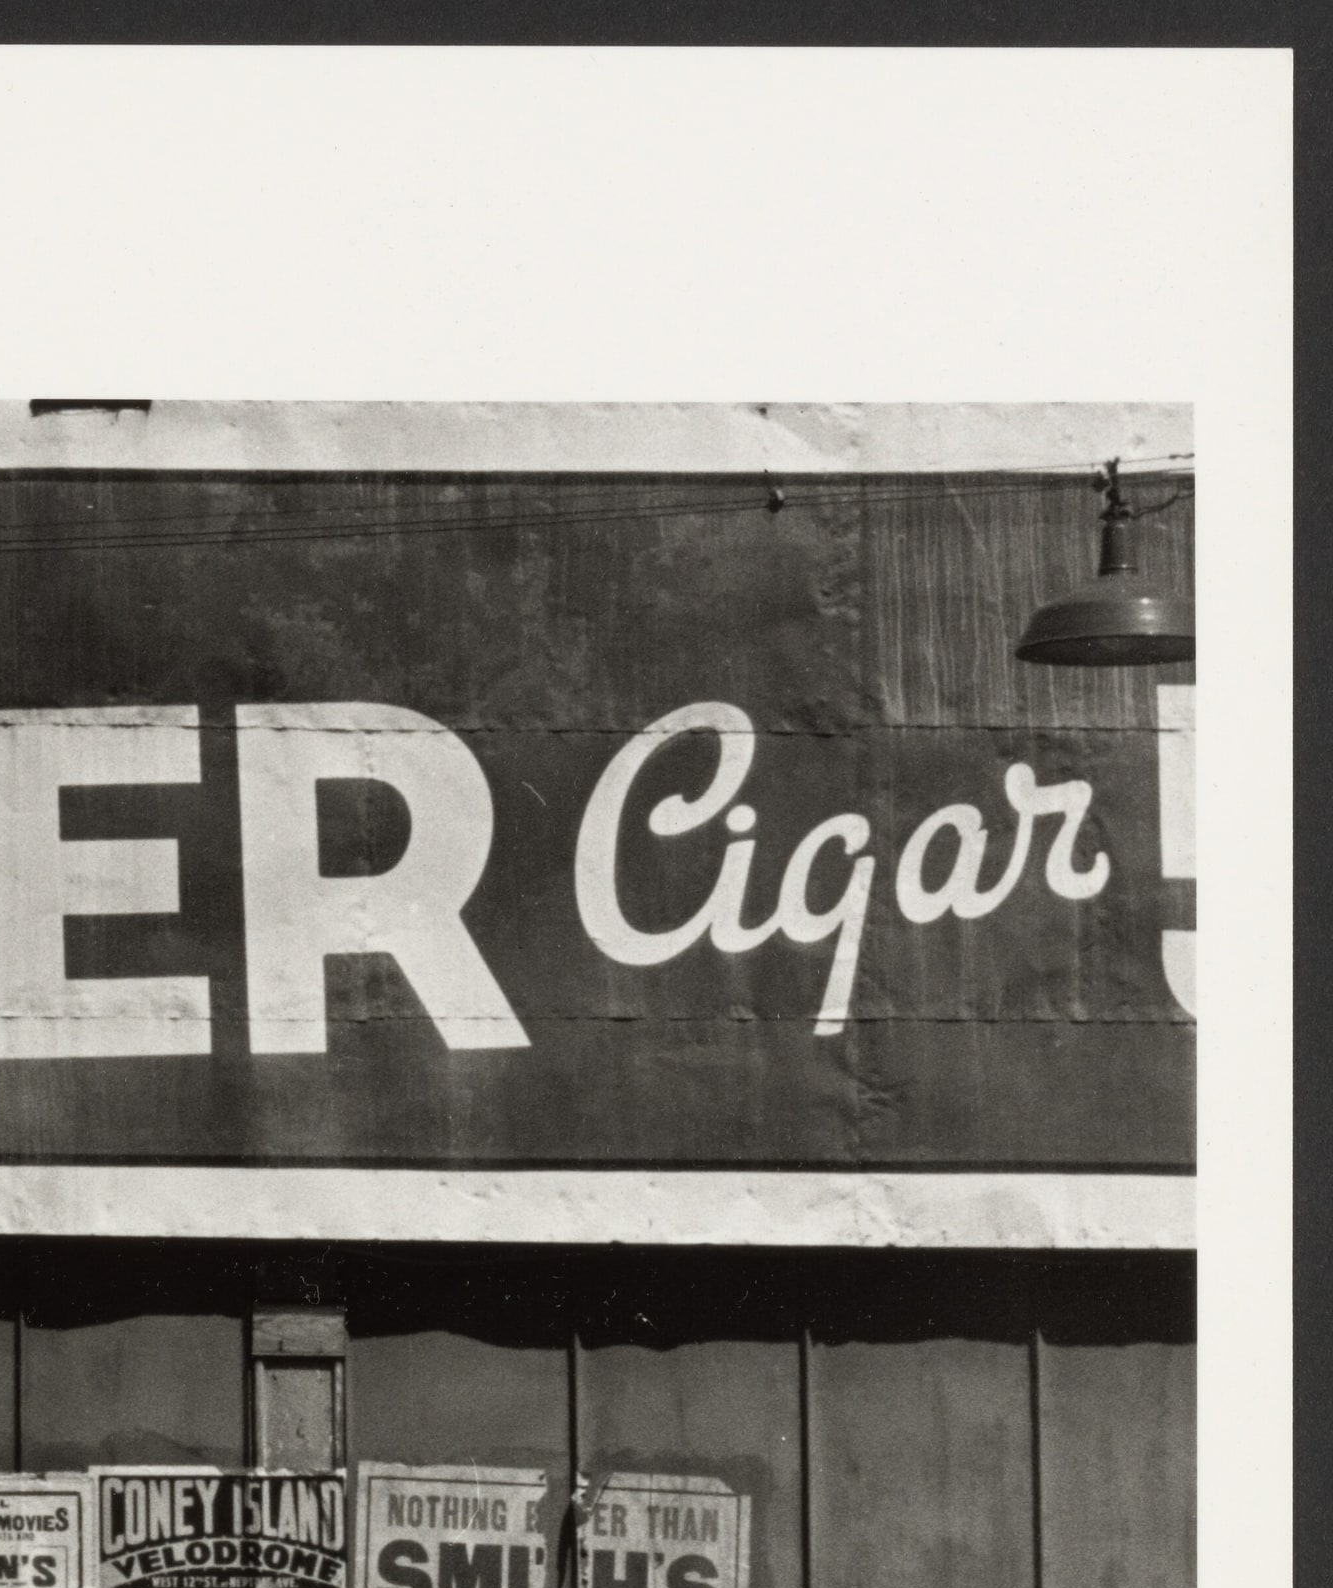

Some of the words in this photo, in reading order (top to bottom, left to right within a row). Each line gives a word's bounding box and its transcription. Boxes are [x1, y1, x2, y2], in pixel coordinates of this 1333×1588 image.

[574, 700, 1110, 1037] Cigar
[103, 1477, 220, 1556] CONEY
[233, 1480, 344, 1551] ISLAND
[387, 1493, 507, 1532] NOTHING
[647, 1505, 718, 1542] THAN
[112, 1540, 342, 1581] VELODROME
